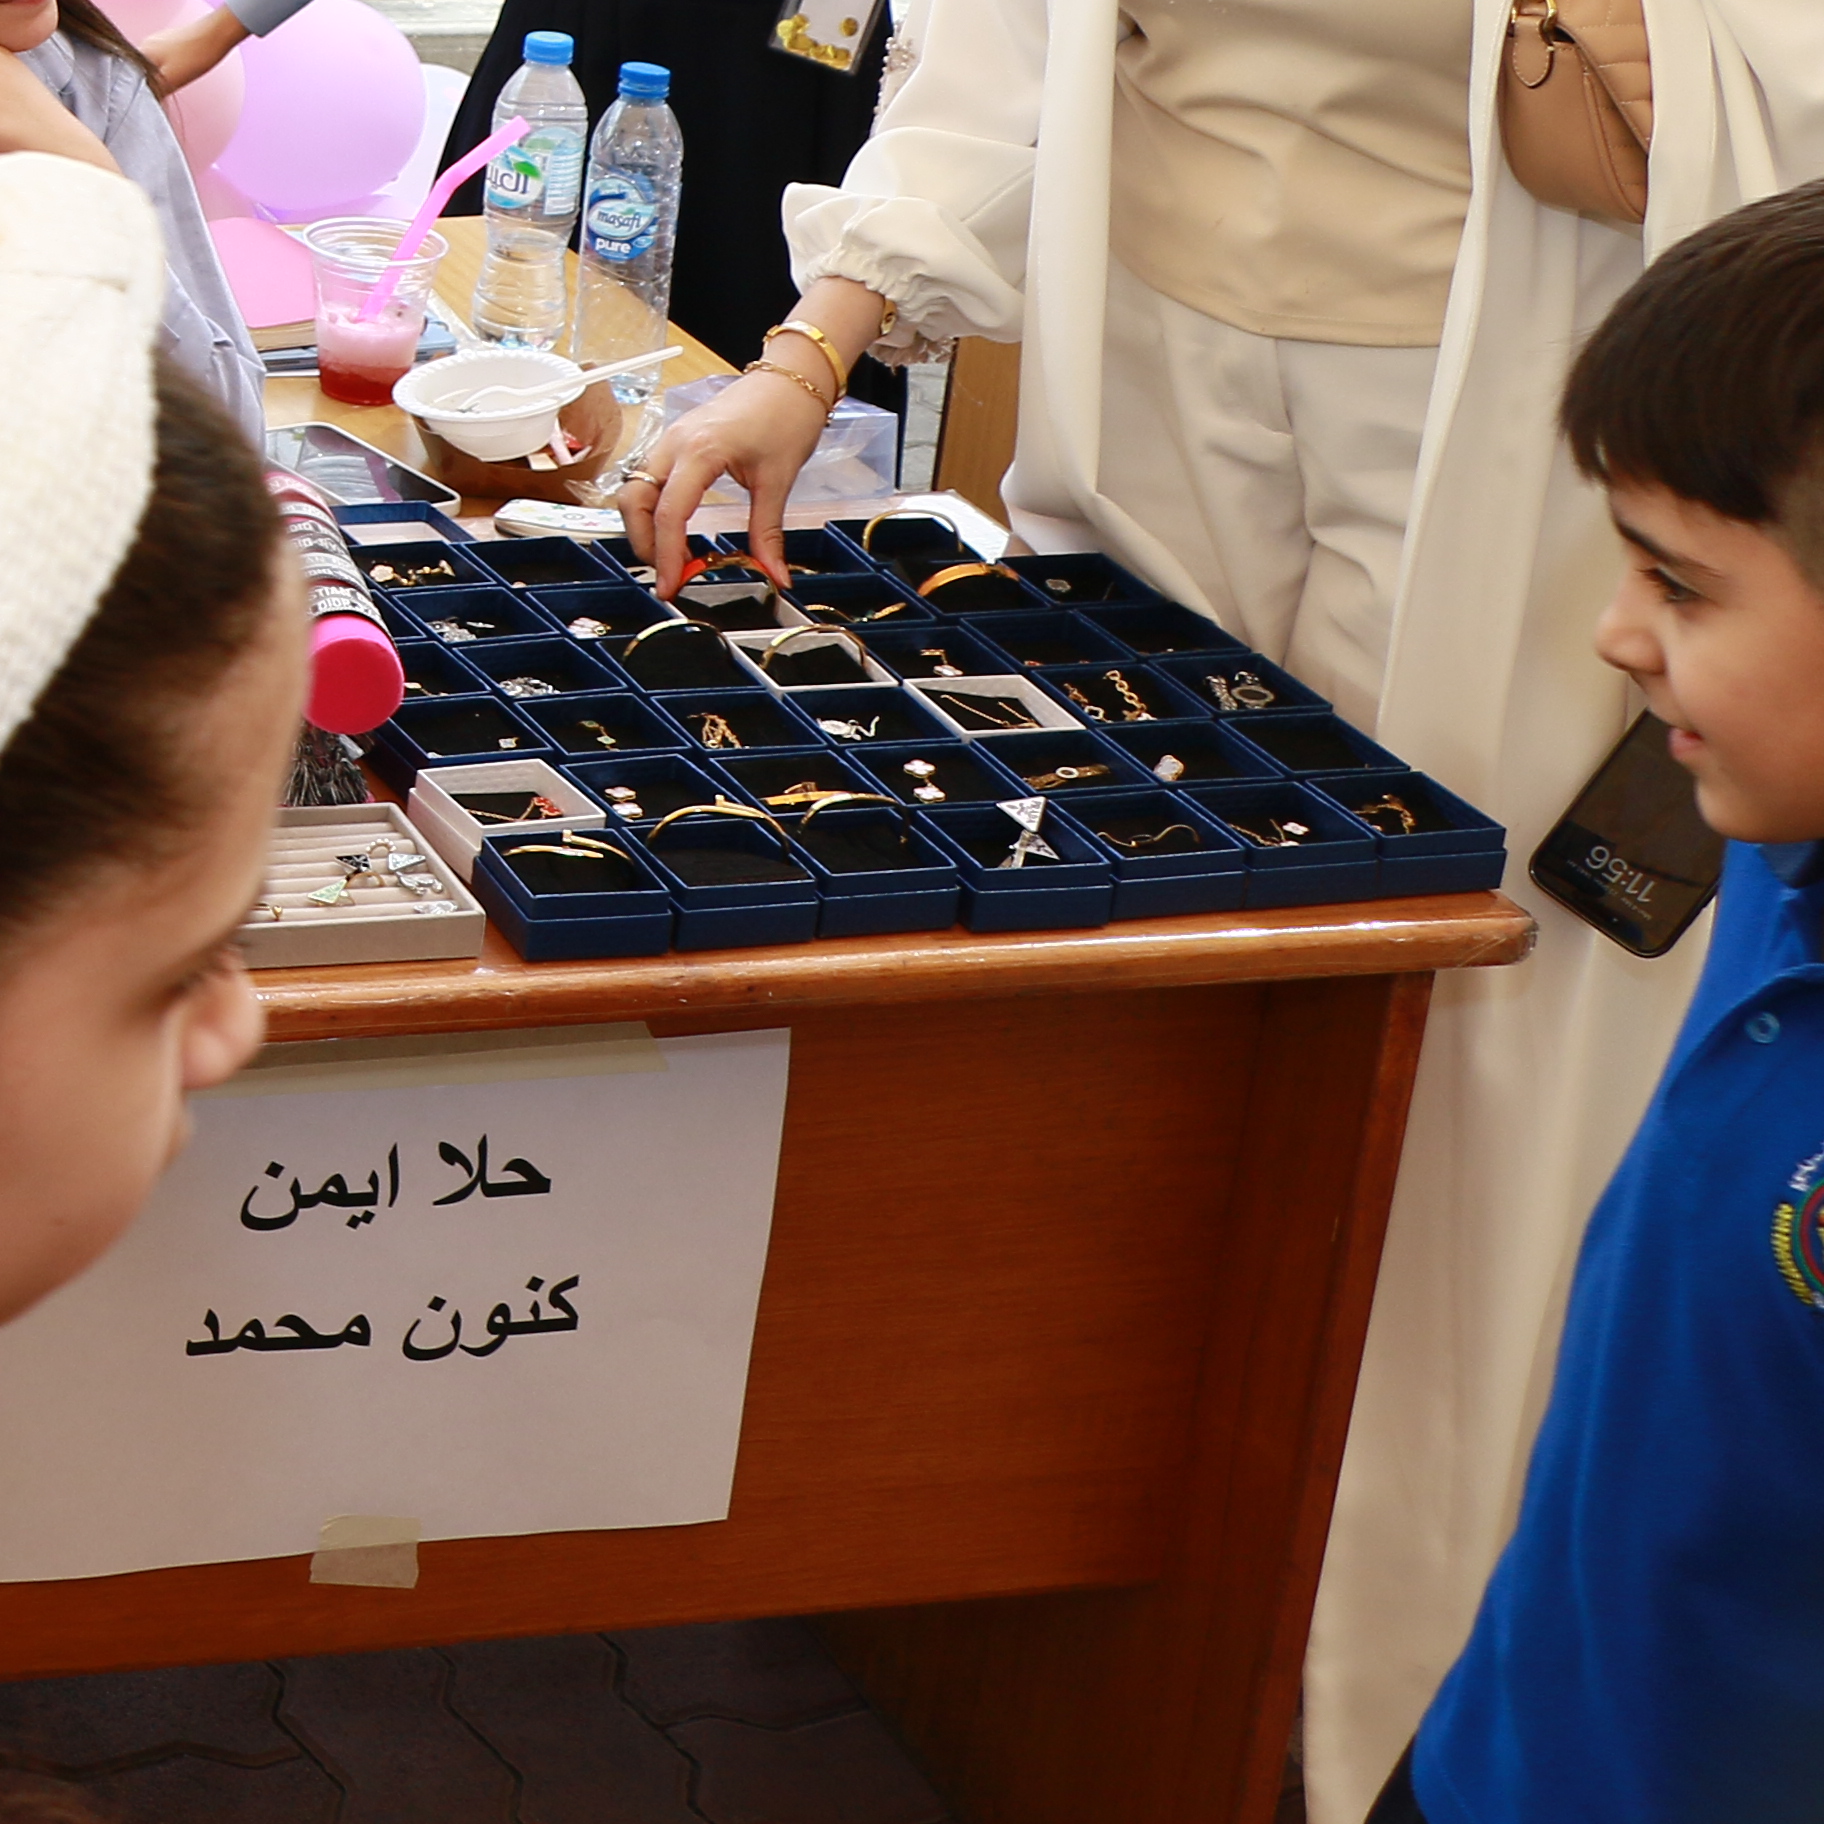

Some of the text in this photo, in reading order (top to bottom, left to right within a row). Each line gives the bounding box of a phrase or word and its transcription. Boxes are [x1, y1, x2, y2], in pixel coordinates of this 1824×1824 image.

[595, 237, 632, 253] pure
[596, 209, 642, 229] masafi
[1585, 845, 1655, 902] 11:56
[239, 1133, 553, 1231] حلا ايمن
[184, 1273, 580, 1362] كنون محمد
